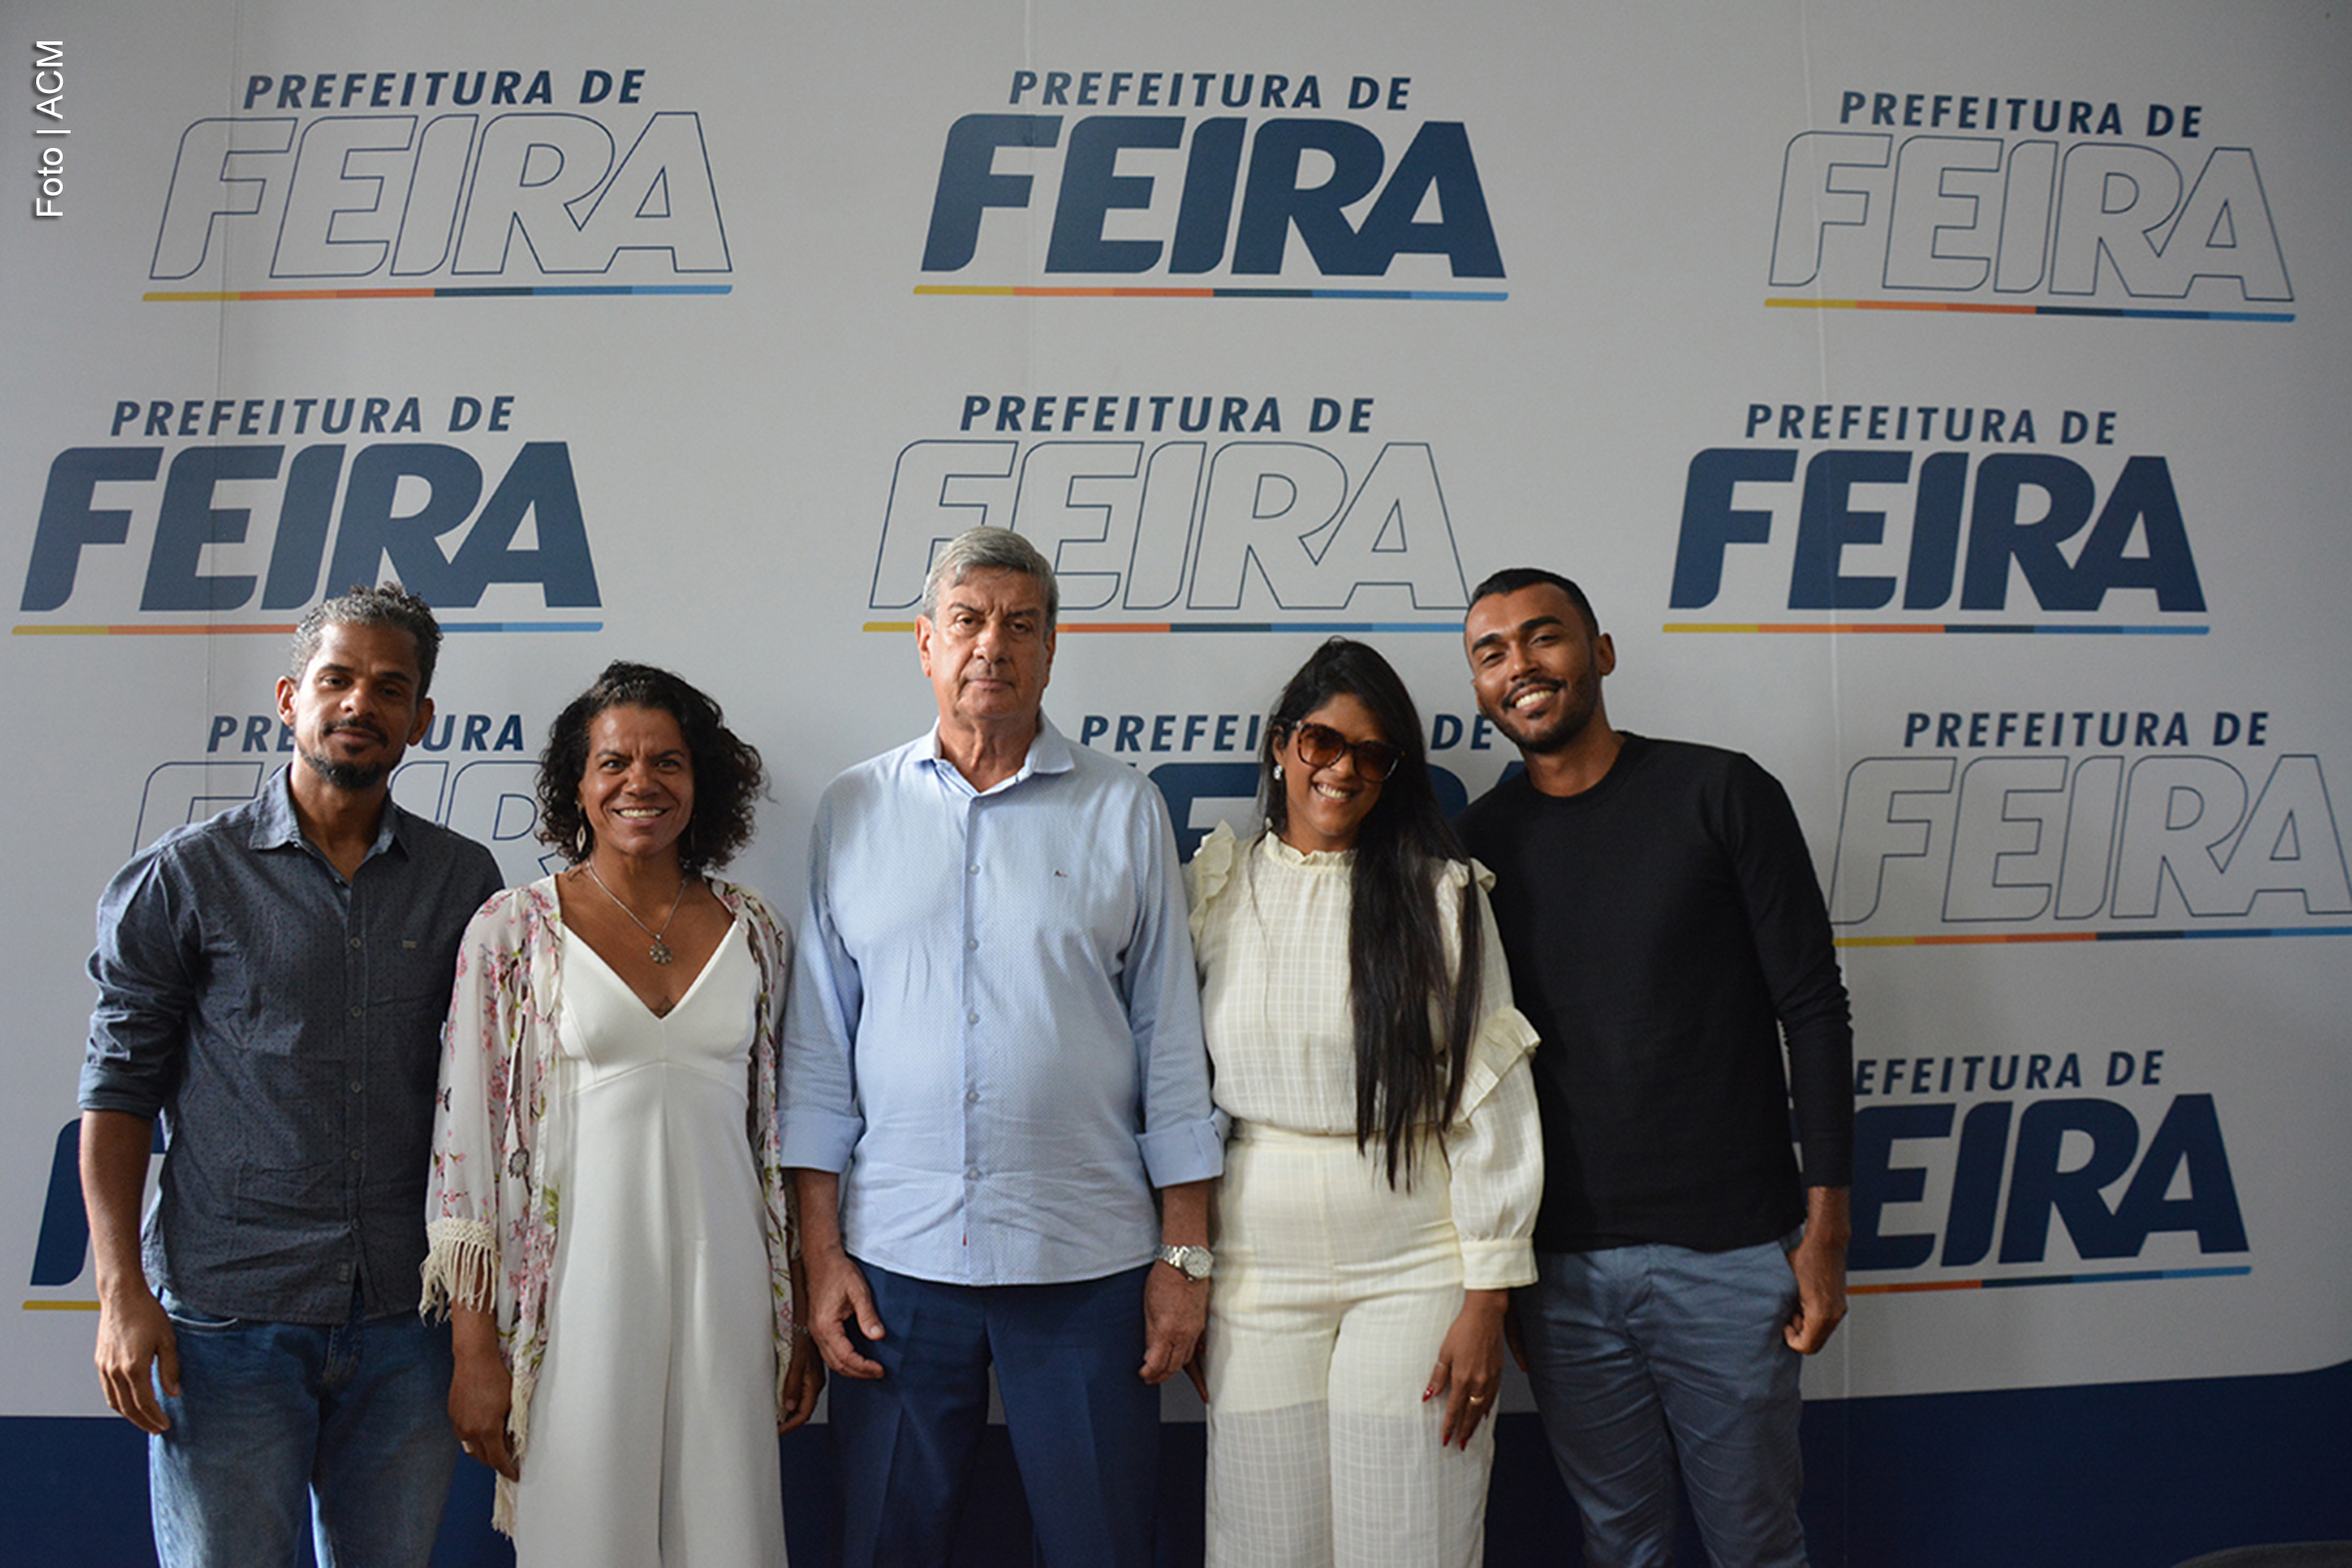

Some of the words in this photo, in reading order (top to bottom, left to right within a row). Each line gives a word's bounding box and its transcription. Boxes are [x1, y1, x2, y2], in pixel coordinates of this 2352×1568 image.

[243, 71, 553, 110] PREFEITURA
[579, 69, 646, 104] DE
[1008, 71, 1321, 109] PREFEITURA
[1348, 75, 1411, 111] DE
[1839, 90, 2123, 136] PREFEITURA
[2146, 104, 2202, 138] DE
[149, 112, 733, 280] FEIRA
[920, 114, 1506, 279] FEIRA
[1769, 130, 2294, 302] FEIRA
[110, 397, 422, 436] PREFEITURA
[448, 395, 514, 432] DE
[959, 395, 1281, 433] PREFEITURA
[1308, 397, 1374, 433] DE
[1745, 404, 2036, 444] PREFEITURA
[2060, 410, 2117, 445] DE
[20, 441, 602, 612] FEIRA
[1668, 448, 2207, 612] FEIRA
[207, 714, 524, 753] PREURA
[1080, 714, 1261, 753] PREFEI
[1430, 713, 1493, 751] DE
[1903, 712, 2189, 748] PREFEITURA
[2212, 711, 2269, 747] DE
[1829, 755, 2352, 924] FEIRA
[1854, 1054, 2082, 1096] EFEITURA
[2107, 1050, 2164, 1087] DE
[1846, 1093, 2250, 1271] EIRA
